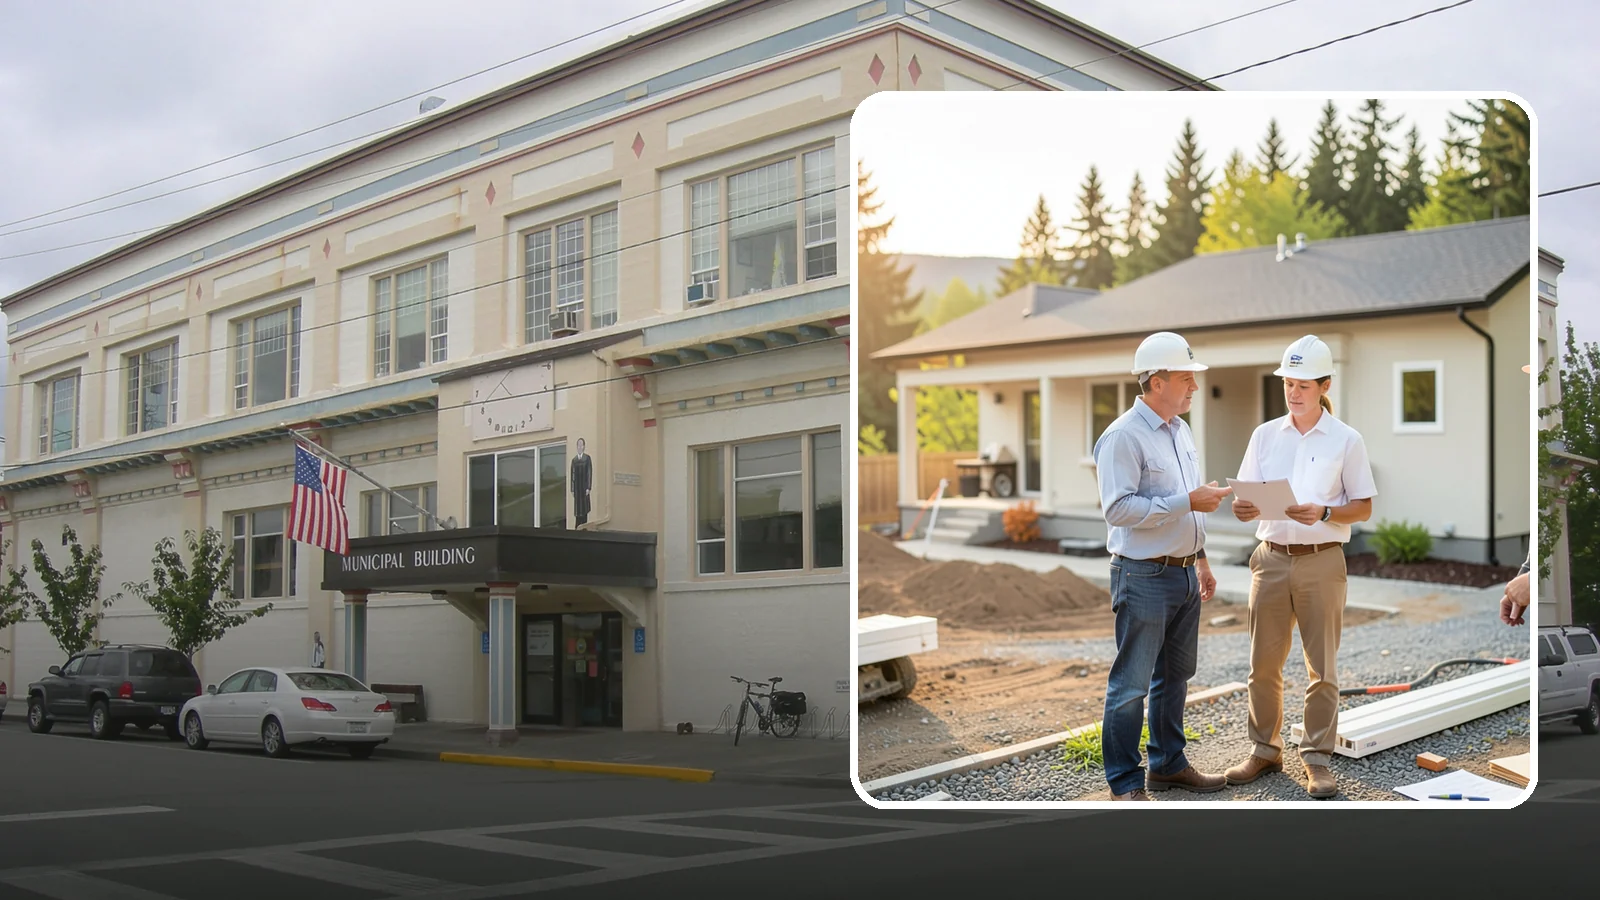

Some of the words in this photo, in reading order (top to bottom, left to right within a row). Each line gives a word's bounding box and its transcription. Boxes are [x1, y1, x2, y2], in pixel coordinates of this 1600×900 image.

[481, 407, 485, 415] 8
[488, 418, 492, 426] 9
[494, 423, 500, 431] 10
[507, 425, 513, 433] 12
[521, 420, 525, 428] 2
[529, 414, 533, 422] 3
[342, 552, 405, 572] MUNICIPAL
[414, 546, 475, 567] BUILDING
